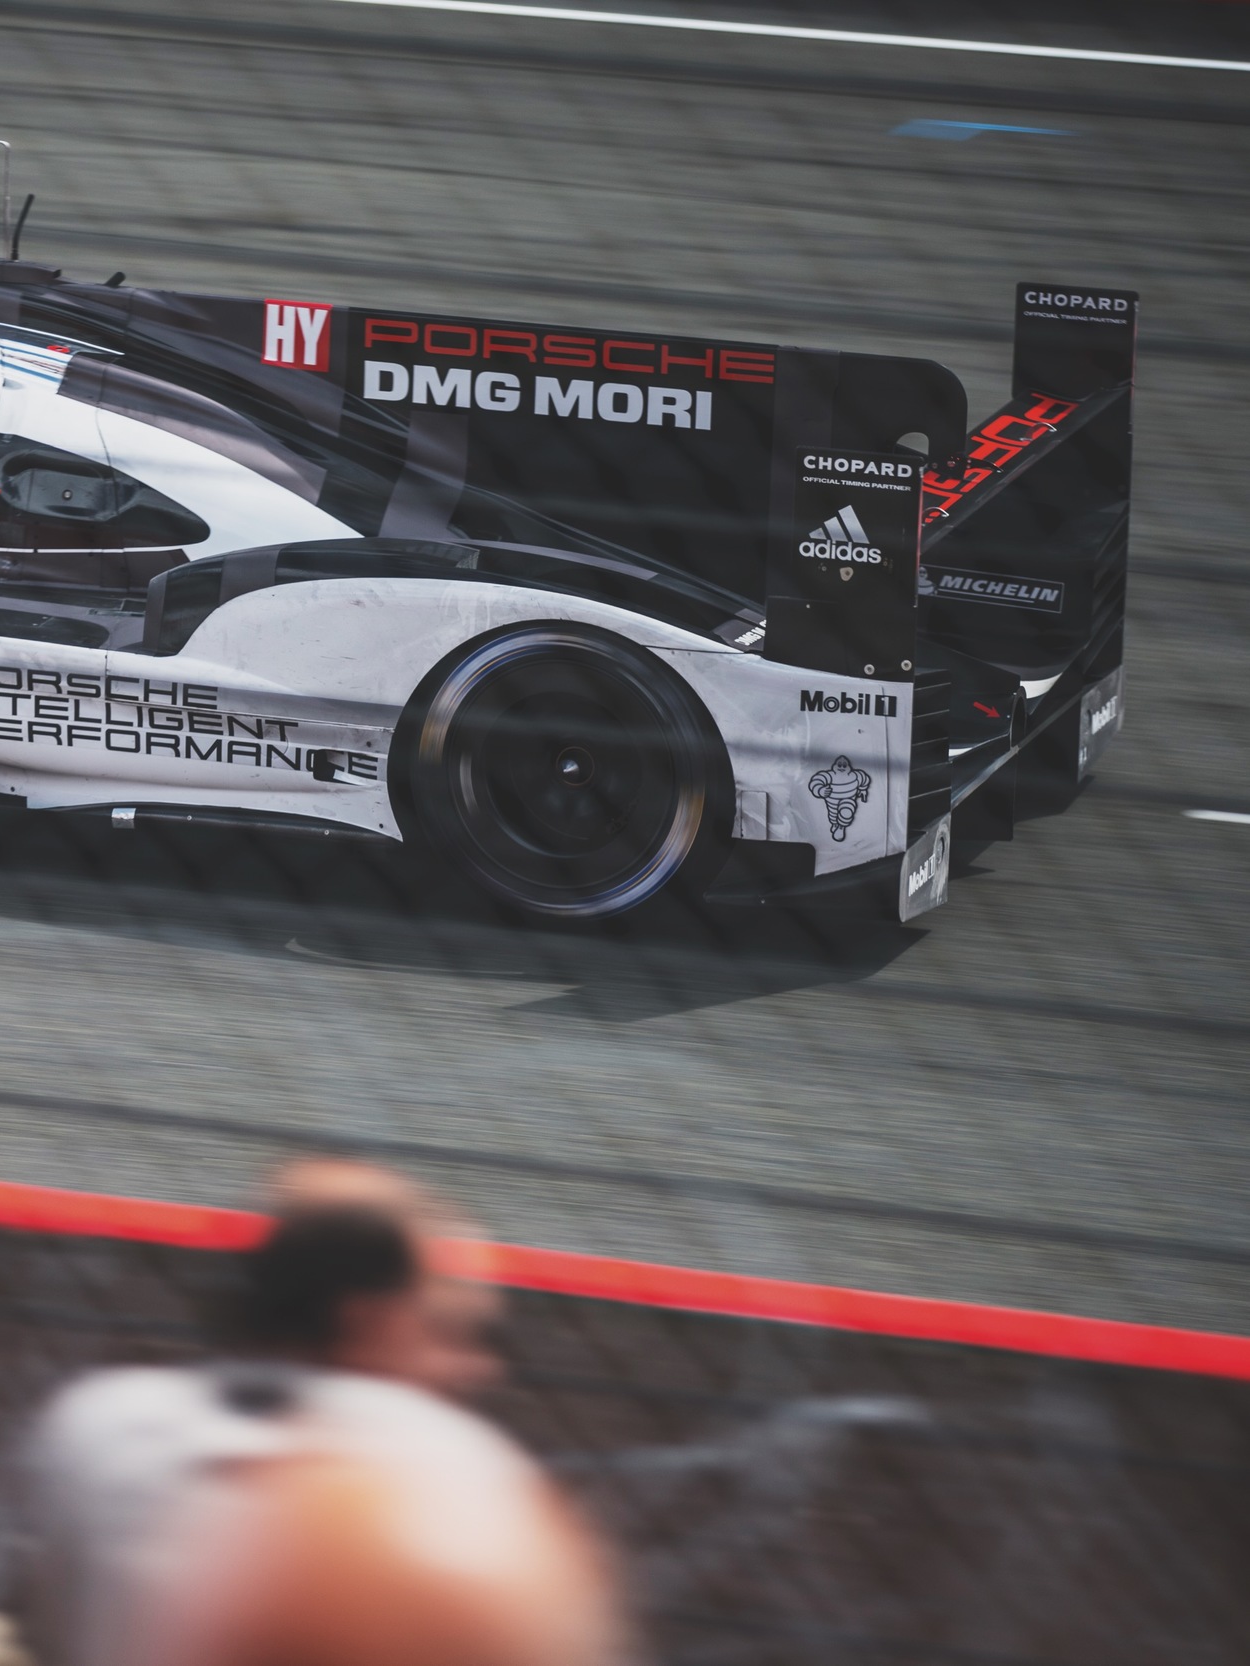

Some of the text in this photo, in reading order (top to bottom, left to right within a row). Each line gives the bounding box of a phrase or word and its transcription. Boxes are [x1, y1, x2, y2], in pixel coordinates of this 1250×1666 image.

[1024, 291, 1128, 312] CHOPARD
[263, 303, 329, 367] HY
[364, 318, 775, 384] PORSCHE
[363, 360, 713, 431] DMG MORI
[803, 455, 913, 478] CHOPARD
[802, 476, 912, 492] OFFICIAL TIMING PARTNER
[798, 539, 882, 564] adidas
[939, 575, 1059, 601] MICHELIN
[800, 689, 871, 716] Mobil
